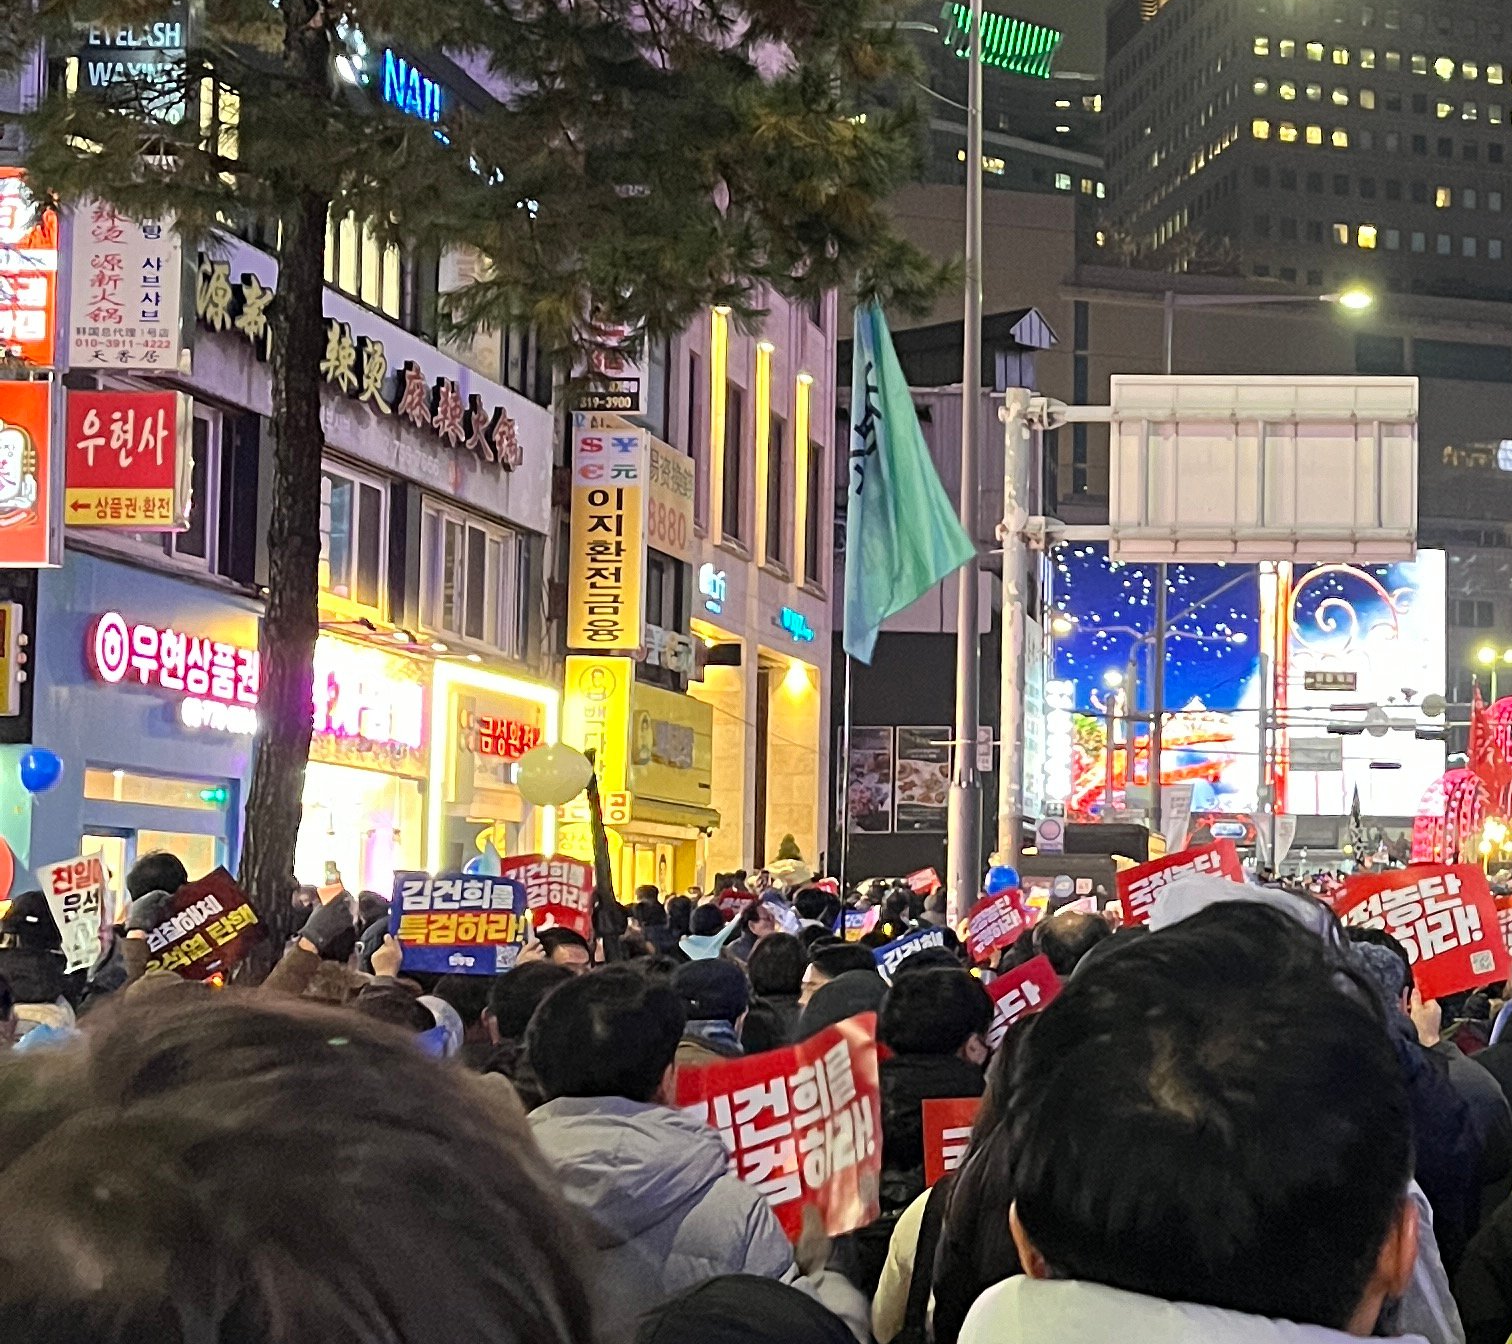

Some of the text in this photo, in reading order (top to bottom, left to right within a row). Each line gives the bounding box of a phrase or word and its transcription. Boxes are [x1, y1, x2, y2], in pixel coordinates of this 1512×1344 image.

[138, 256, 163, 323] 샤브샤브
[76, 408, 169, 468] 우현사
[583, 487, 627, 643] 이지환전금융
[131, 624, 260, 705] 우현상품권
[401, 879, 514, 910] 김건희를
[526, 883, 589, 913] 검하라!
[1341, 873, 1463, 930] 정농단
[398, 913, 526, 944] 특검하라!
[728, 1096, 875, 1206] 검하라!
